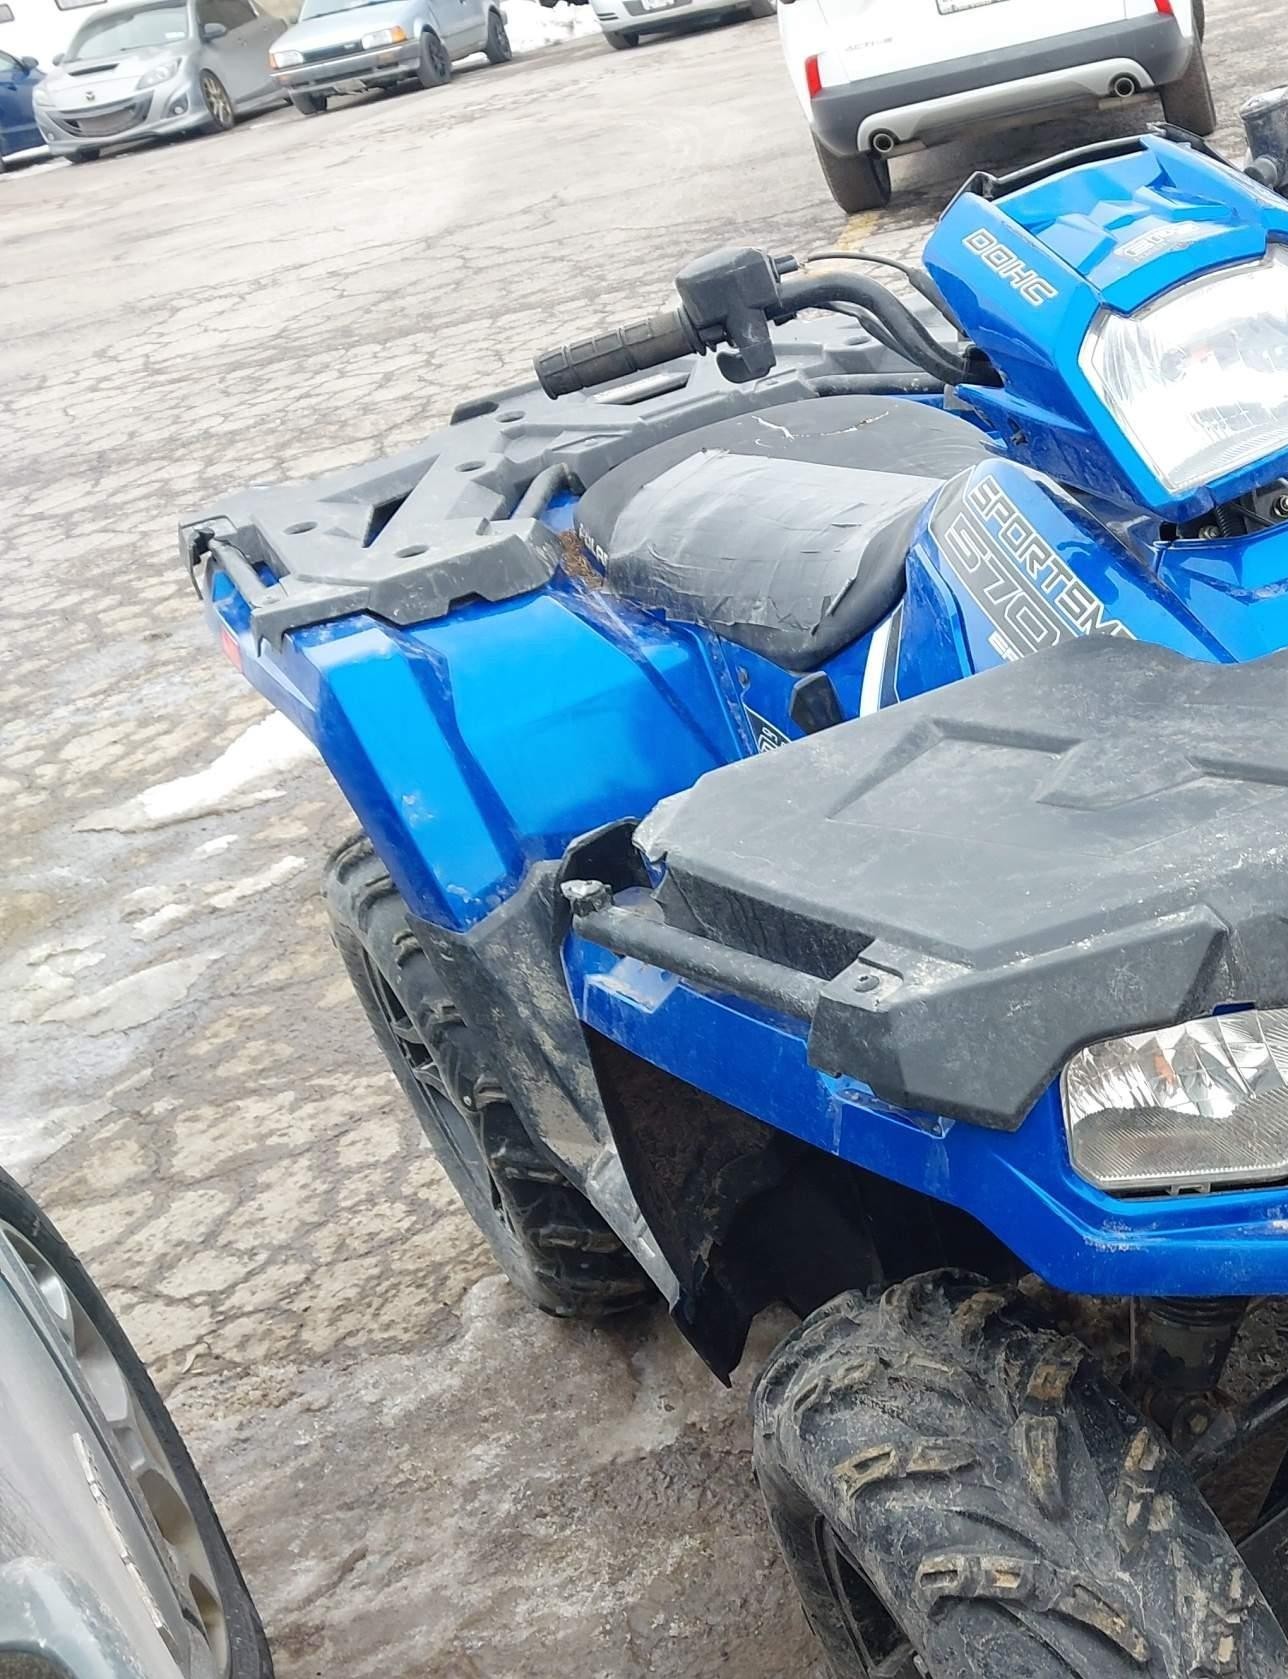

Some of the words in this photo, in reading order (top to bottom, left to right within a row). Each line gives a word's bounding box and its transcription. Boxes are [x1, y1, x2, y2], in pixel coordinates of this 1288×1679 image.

[962, 228, 1059, 307] DOHC
[945, 512, 1060, 652] 570
[968, 474, 1137, 640] SPORTSM
